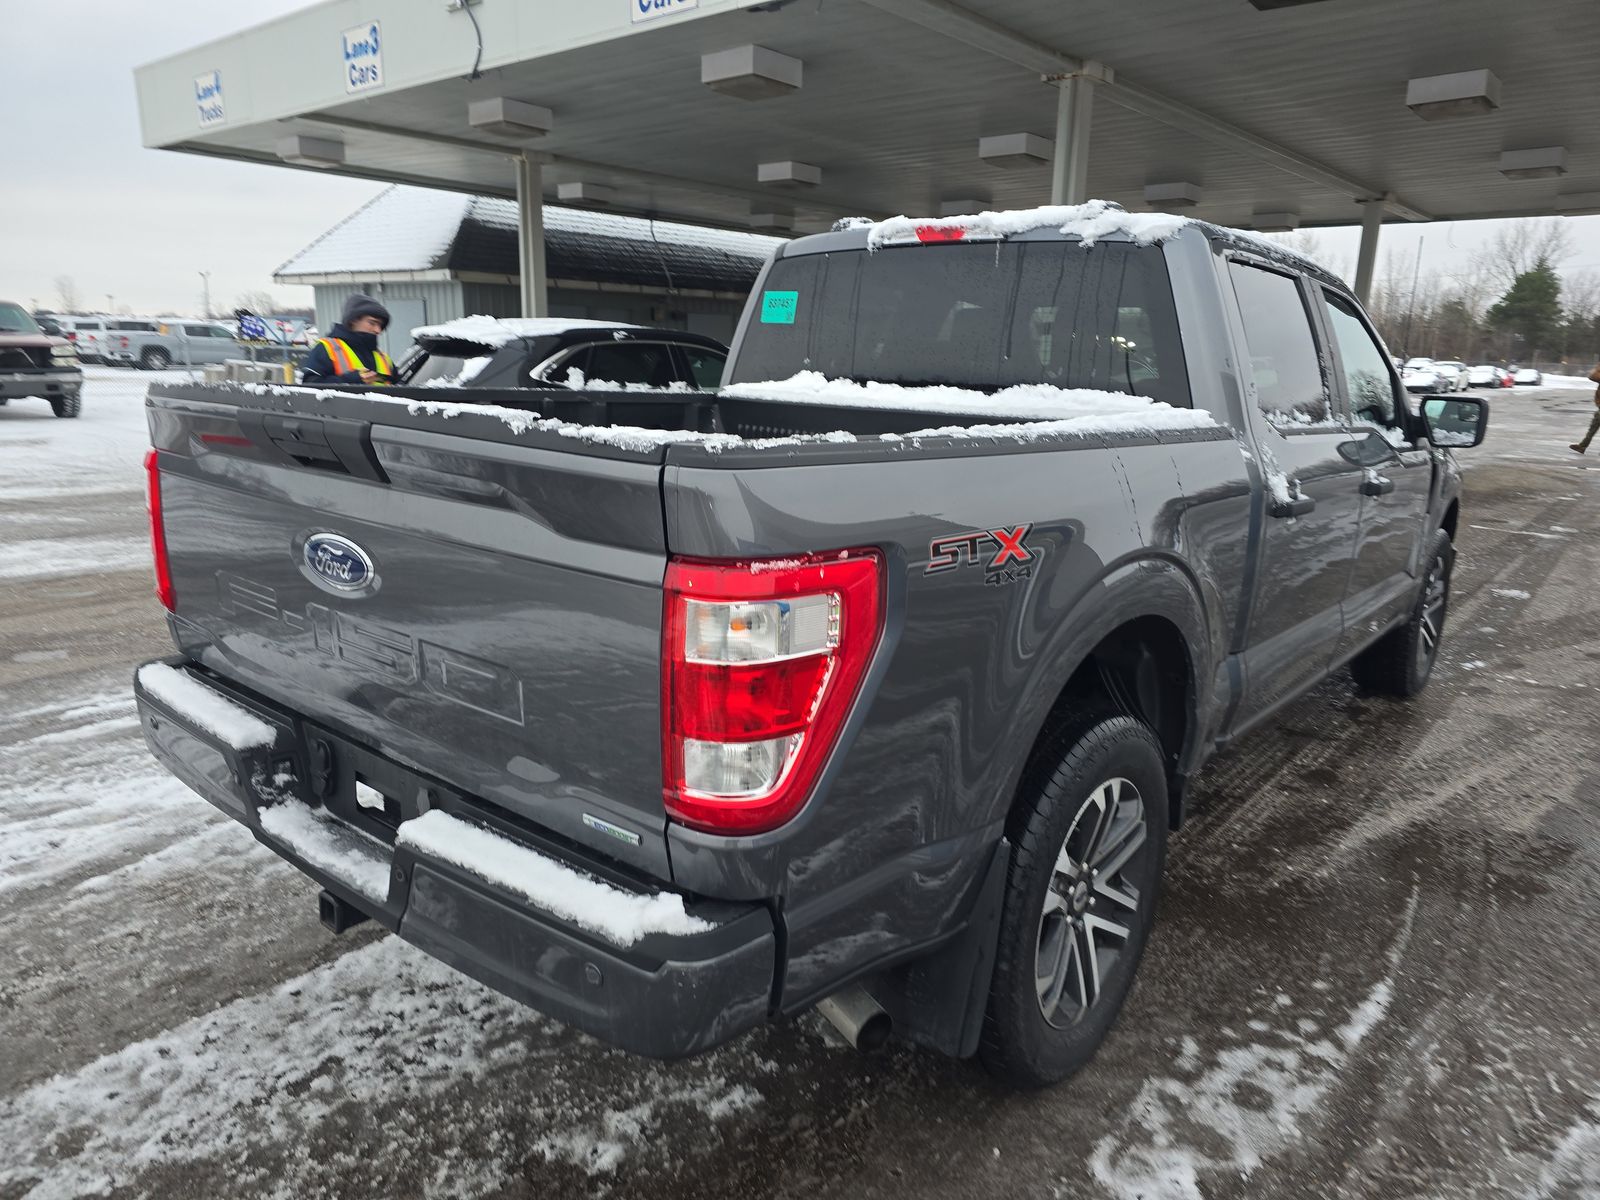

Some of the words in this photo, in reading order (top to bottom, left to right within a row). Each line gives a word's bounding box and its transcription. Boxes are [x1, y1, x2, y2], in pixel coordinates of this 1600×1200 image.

[343, 34, 369, 60] Lane
[370, 24, 379, 56] 3
[349, 63, 378, 87] Cars
[315, 543, 353, 580] Ford
[923, 521, 1037, 577] STX
